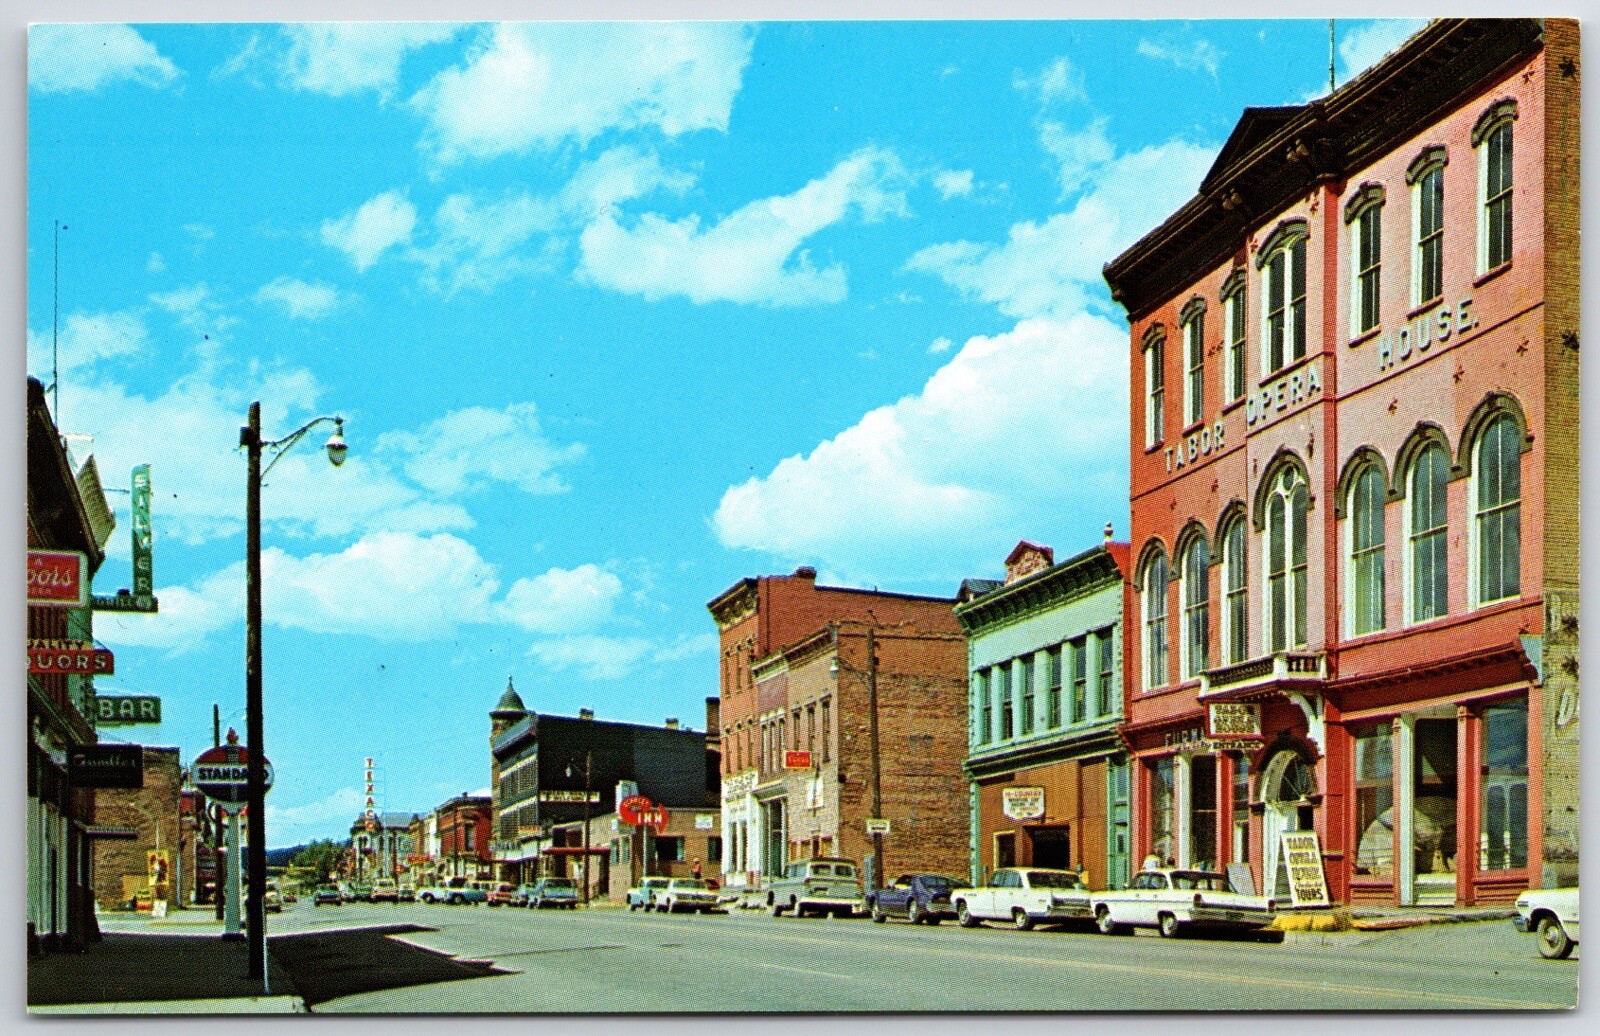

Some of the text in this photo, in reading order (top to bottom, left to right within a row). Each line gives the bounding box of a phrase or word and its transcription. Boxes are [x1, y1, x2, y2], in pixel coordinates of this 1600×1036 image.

[1164, 419, 1226, 475] TABOR
[1246, 364, 1321, 427] OPERA
[134, 473, 150, 590] SILVER
[99, 699, 155, 718] BAR
[198, 767, 269, 779] STANDAD
[637, 812, 663, 823] INN
[1296, 888, 1324, 901] TOURS
